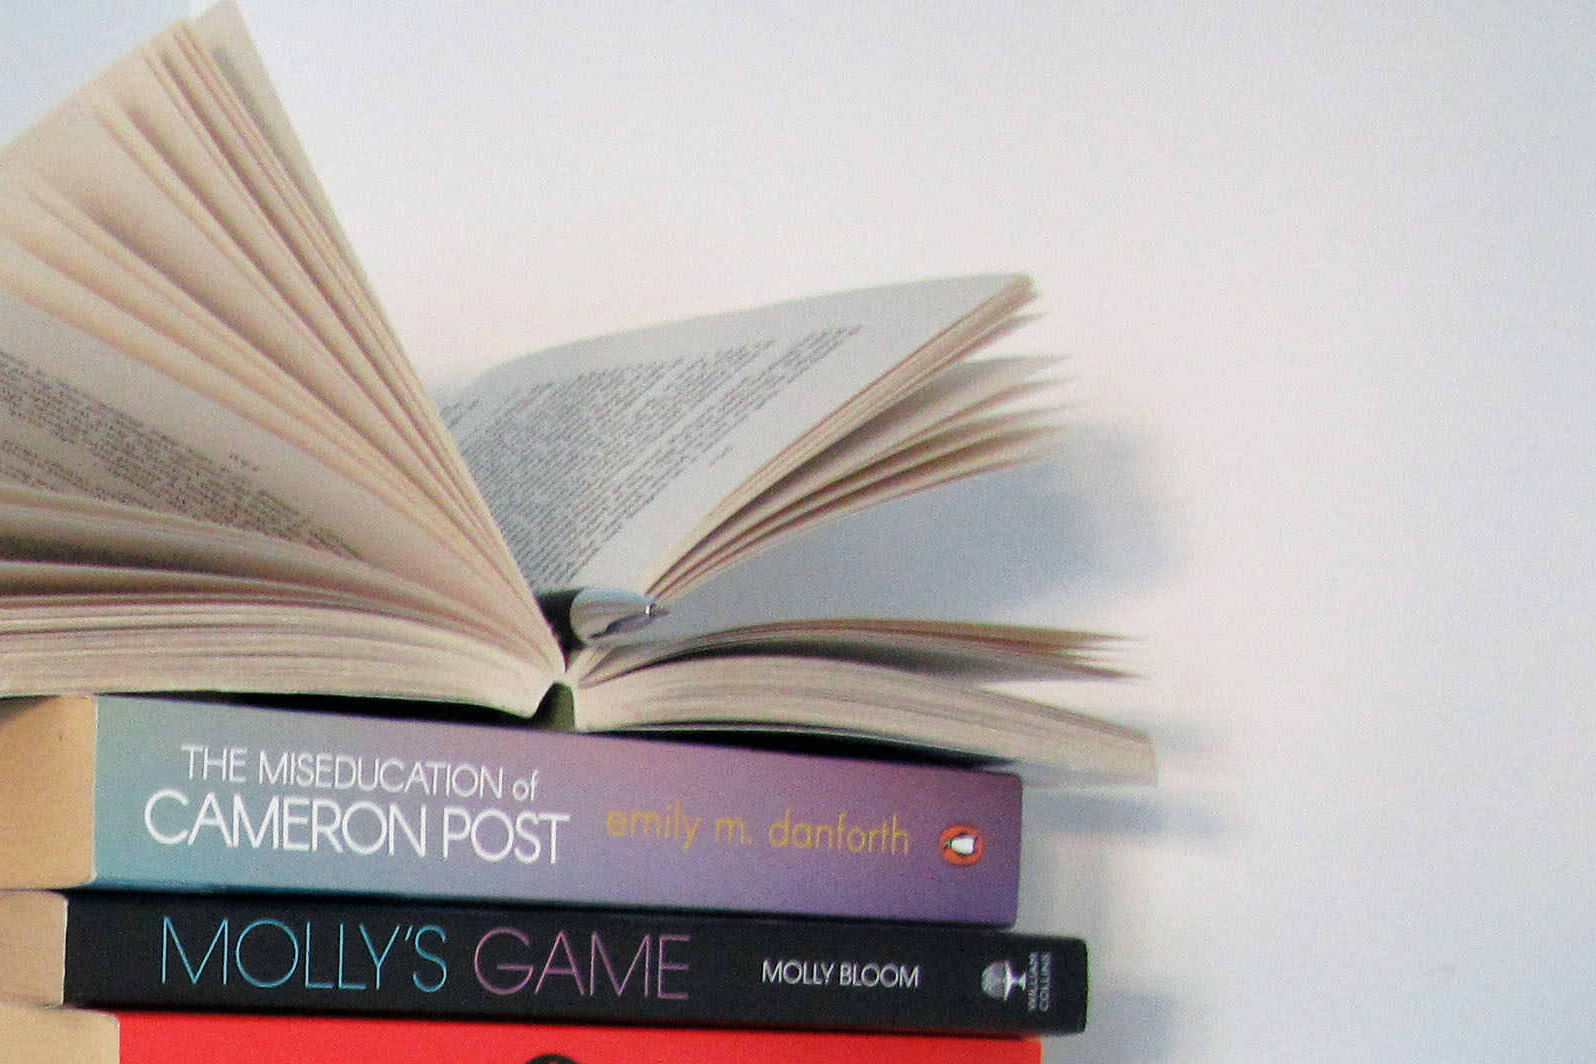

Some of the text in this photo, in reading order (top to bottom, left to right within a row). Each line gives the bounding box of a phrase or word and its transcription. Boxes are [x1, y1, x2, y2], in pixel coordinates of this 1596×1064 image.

[181, 744, 539, 801] THE MISEDUCATION of
[144, 788, 571, 864] CAMERON POST
[606, 802, 910, 855] emily m. danforth
[160, 916, 691, 999] MOLLY'S GAME
[761, 960, 920, 989] MOLLY BLOOM
